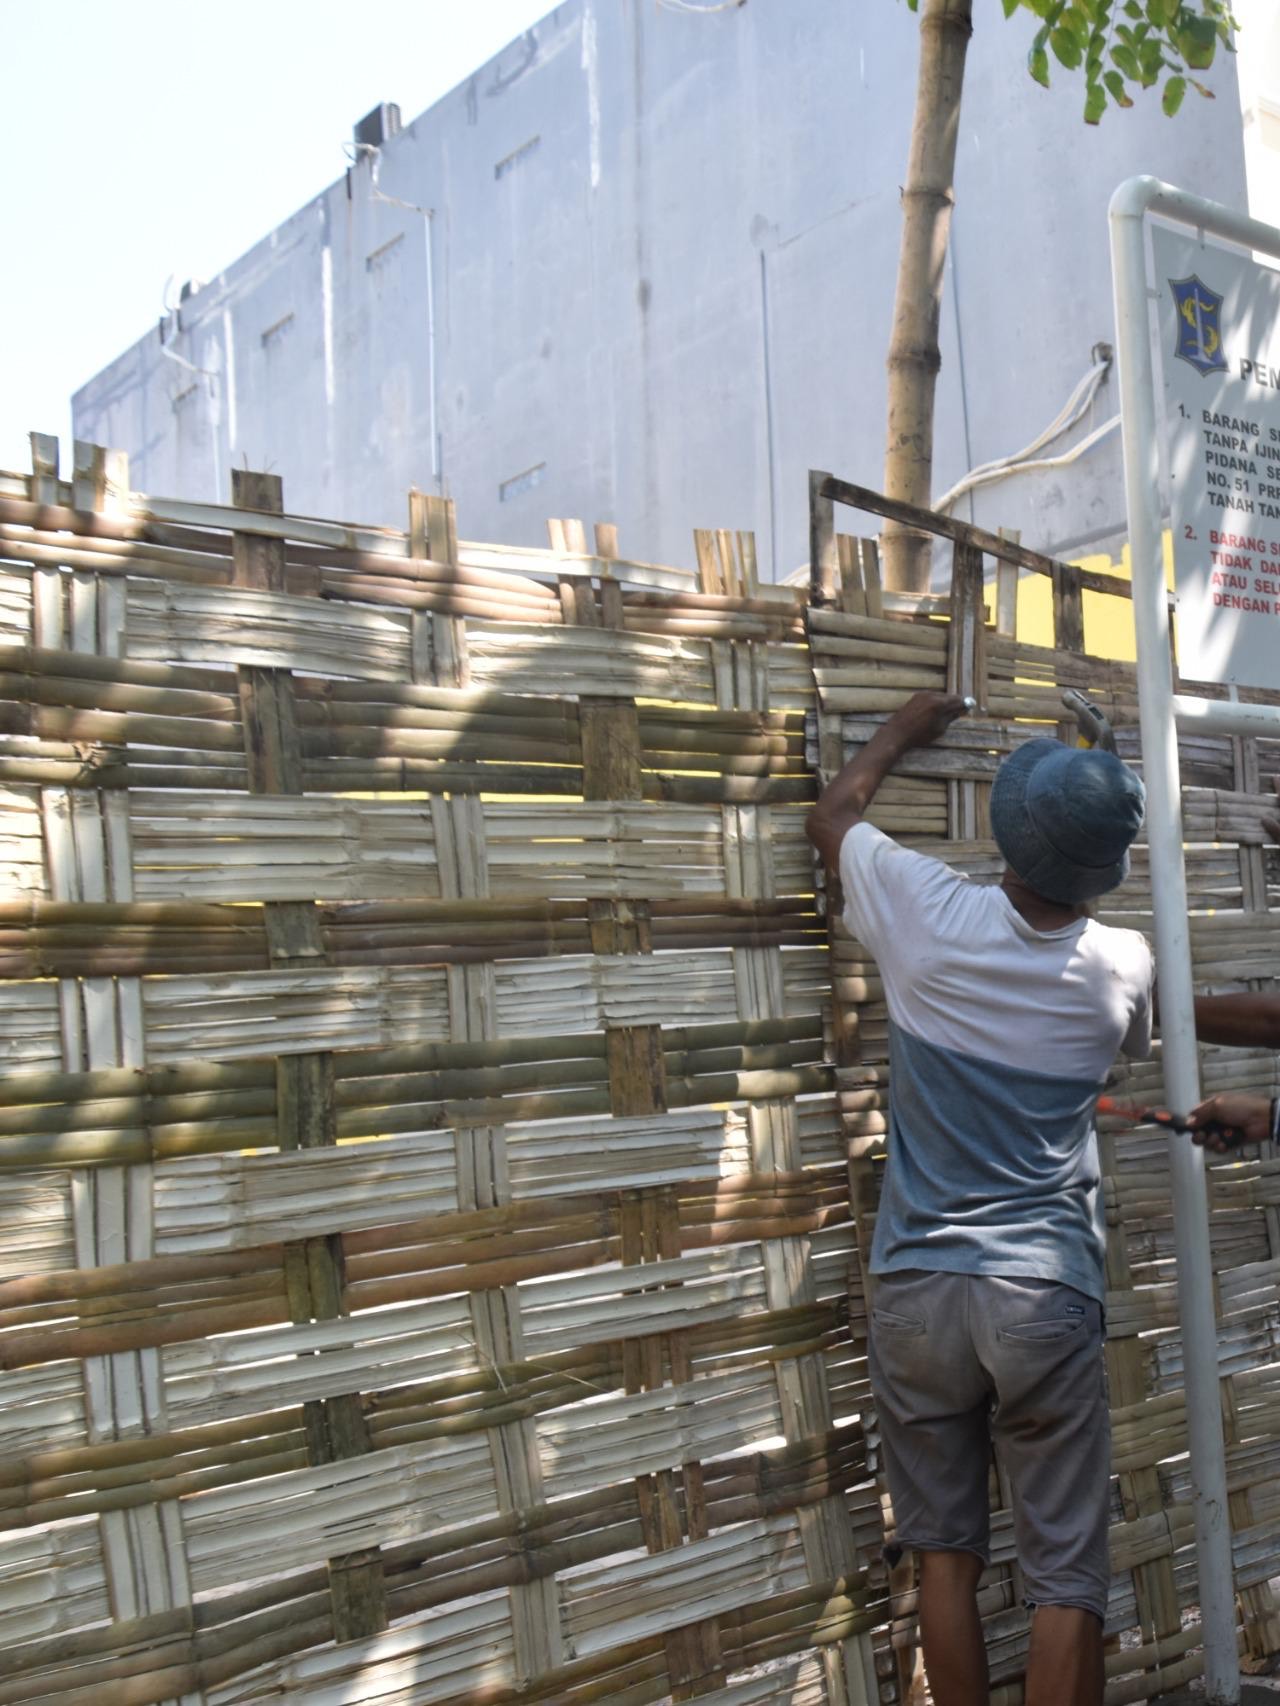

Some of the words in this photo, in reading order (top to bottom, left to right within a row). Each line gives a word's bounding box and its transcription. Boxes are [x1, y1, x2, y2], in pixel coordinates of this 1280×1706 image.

[1179, 405, 1190, 419] 1.
[1203, 410, 1259, 436] BARANG
[1204, 431, 1248, 453] TANPA
[1255, 444, 1280, 460] IJIN
[1206, 451, 1257, 474] PIDANA
[1207, 472, 1230, 488] NO.
[1235, 480, 1249, 492] 51
[1208, 492, 1254, 512] TANAH
[1184, 526, 1197, 540] 2.
[1210, 530, 1265, 553] BARANG
[1210, 551, 1252, 570] TIDAK
[1212, 573, 1247, 589] ATAU
[1214, 593, 1269, 614] DENGAN
